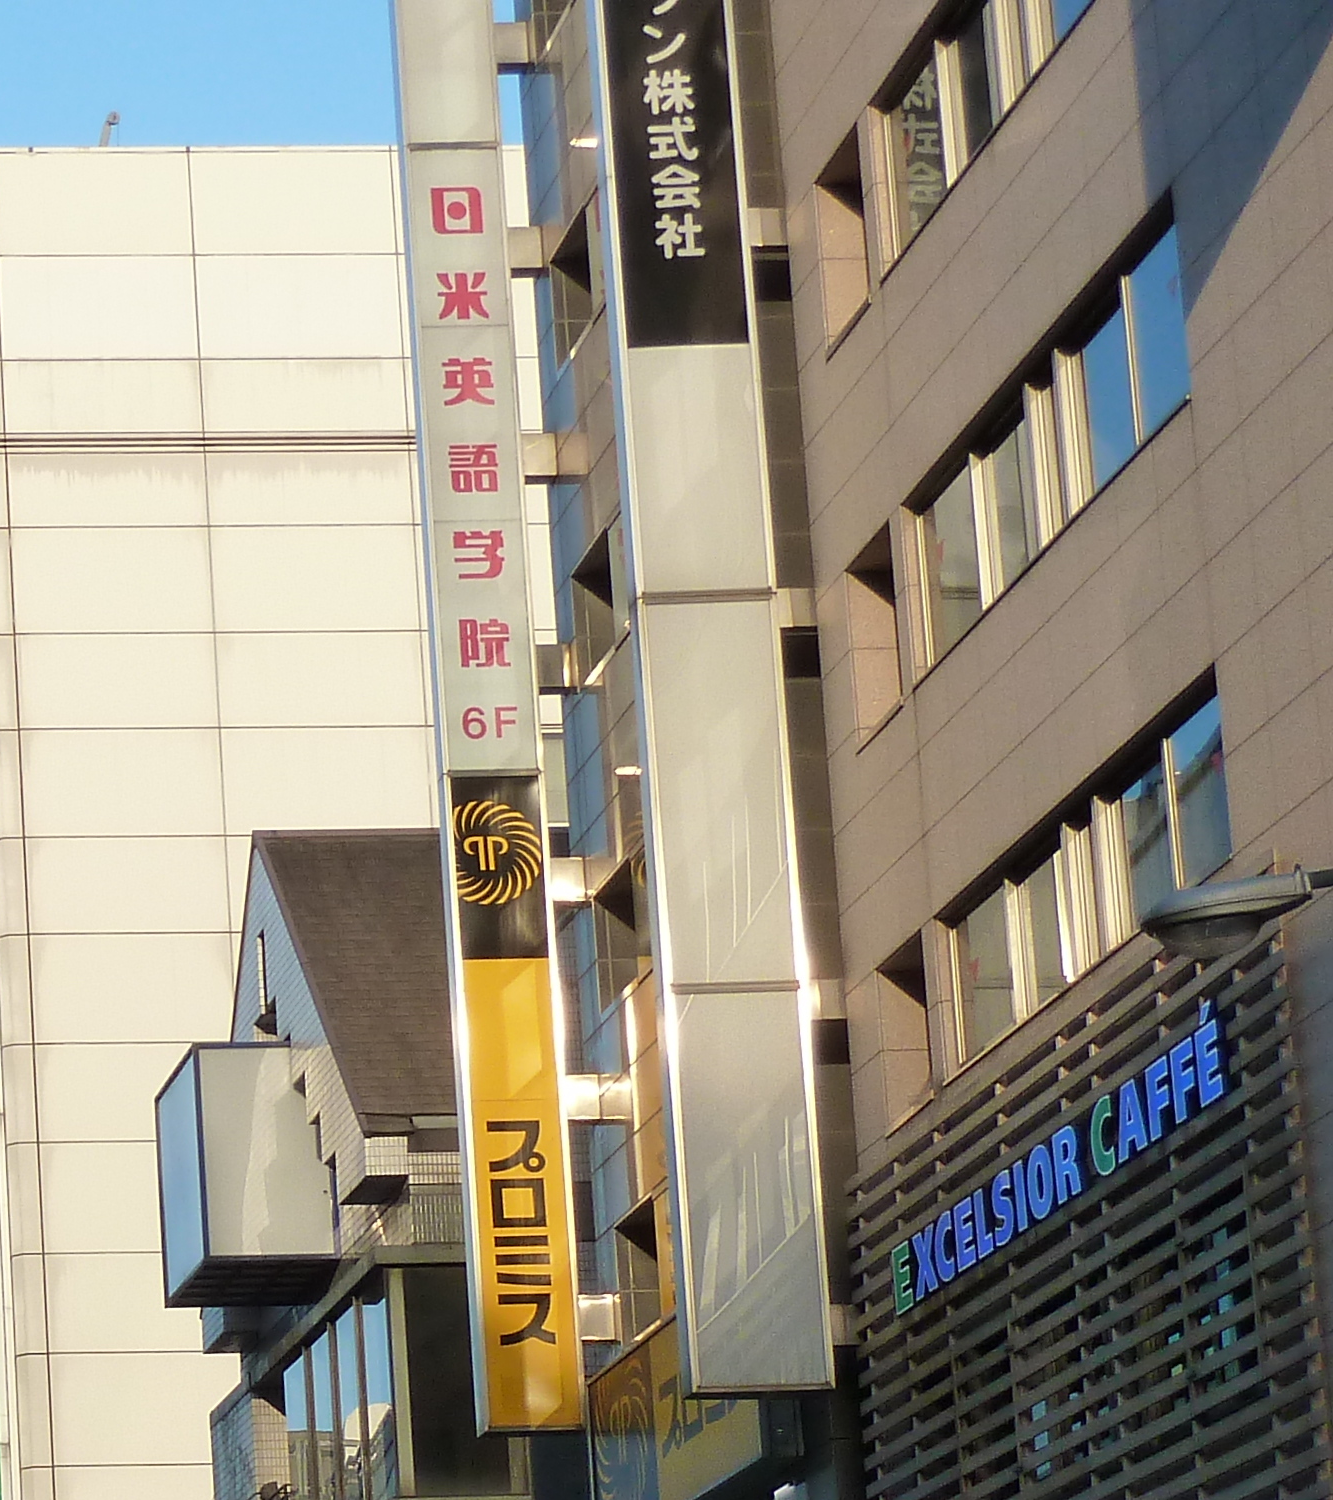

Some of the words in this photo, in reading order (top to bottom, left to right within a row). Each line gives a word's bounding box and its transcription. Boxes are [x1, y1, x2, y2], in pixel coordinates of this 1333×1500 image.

[429, 185, 513, 668] 日米英語学院
[461, 706, 518, 741] 6F
[485, 1119, 557, 1346] プロミス
[891, 1124, 1084, 1316] EXCELSIOR
[1090, 1000, 1226, 1177] CAFFÉ
